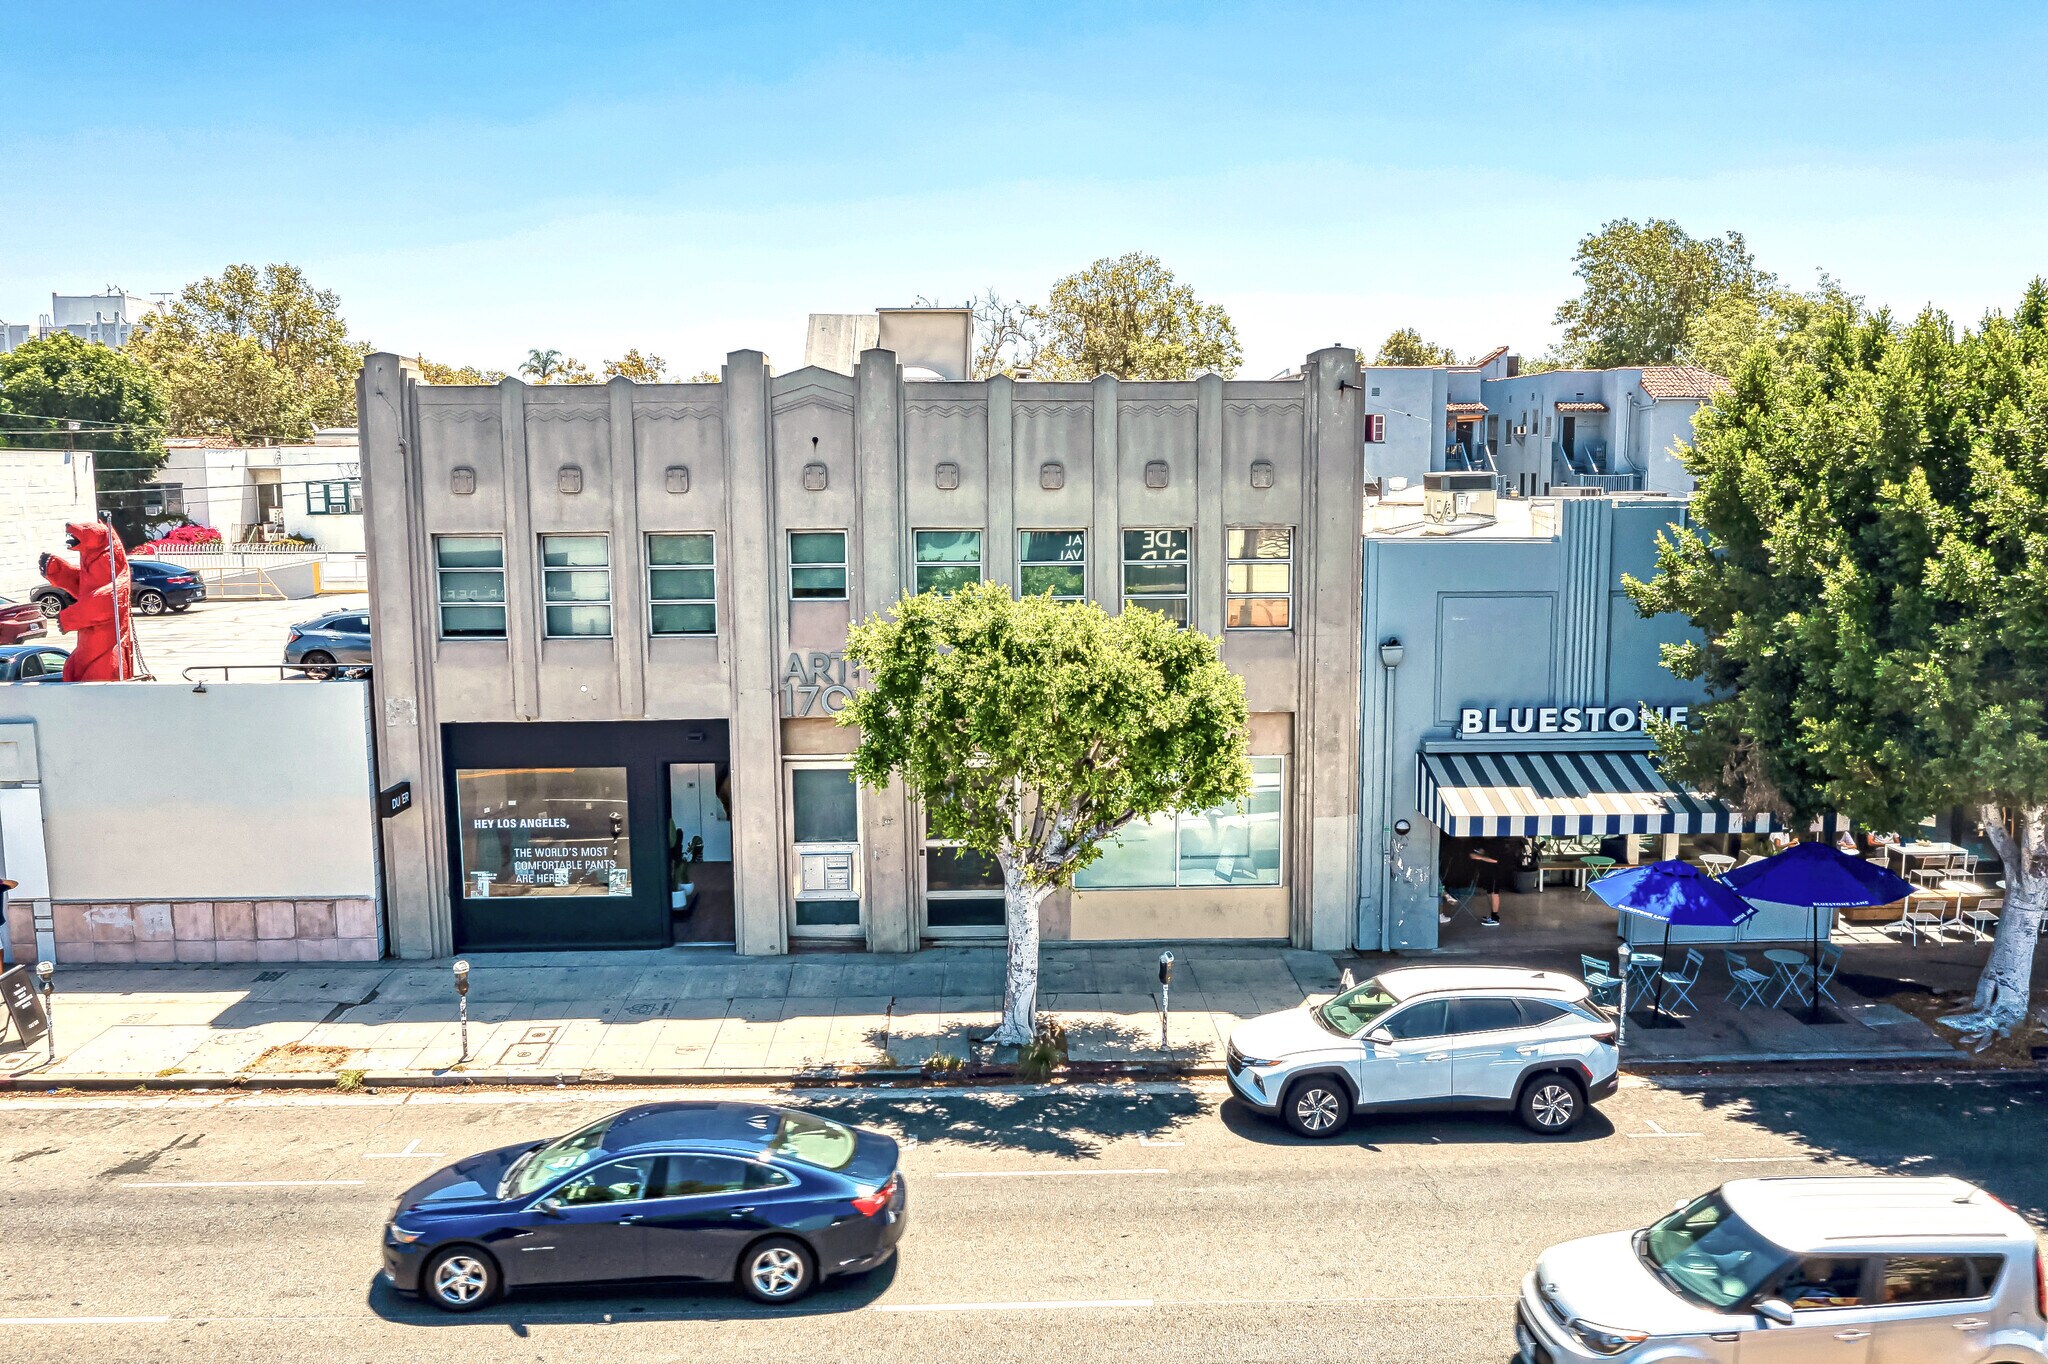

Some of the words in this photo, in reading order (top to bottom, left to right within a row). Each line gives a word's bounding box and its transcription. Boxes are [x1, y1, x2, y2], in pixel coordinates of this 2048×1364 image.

[1461, 707, 1688, 733] BLUESTONE
[474, 820, 494, 829] HEY
[497, 819, 517, 828] LOS
[519, 818, 570, 829] ANGELES,
[514, 848, 532, 857] THE
[534, 847, 578, 857] WORLD'S
[580, 847, 608, 856] MOST
[514, 860, 582, 870] COMFORTABLE
[585, 860, 616, 869] PANTS
[515, 874, 534, 883] ARE
